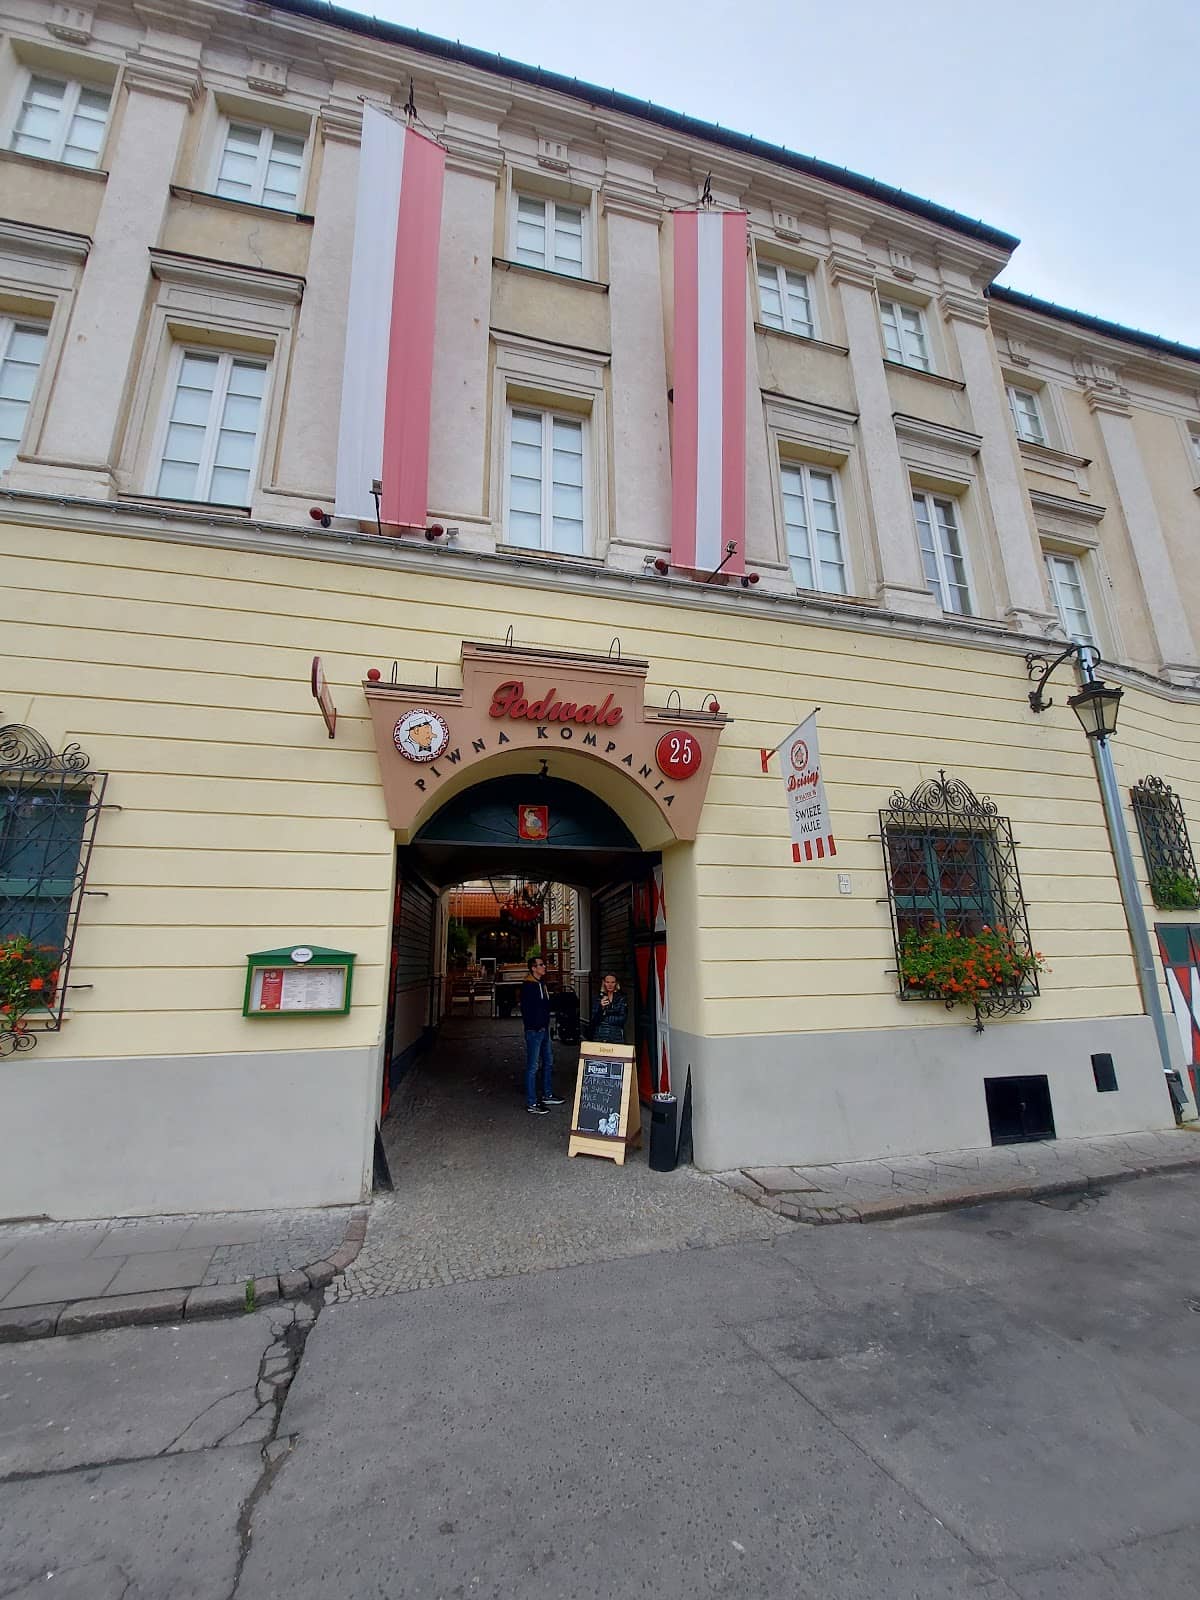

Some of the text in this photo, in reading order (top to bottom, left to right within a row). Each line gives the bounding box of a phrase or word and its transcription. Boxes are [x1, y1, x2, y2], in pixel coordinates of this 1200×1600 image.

[489, 681, 623, 727] Podwale
[669, 738, 692, 764] 25
[414, 731, 510, 792] PIWNA
[536, 726, 675, 807] KOMPANIA
[787, 766, 819, 792] Dzisiaj
[801, 819, 821, 834] MULE
